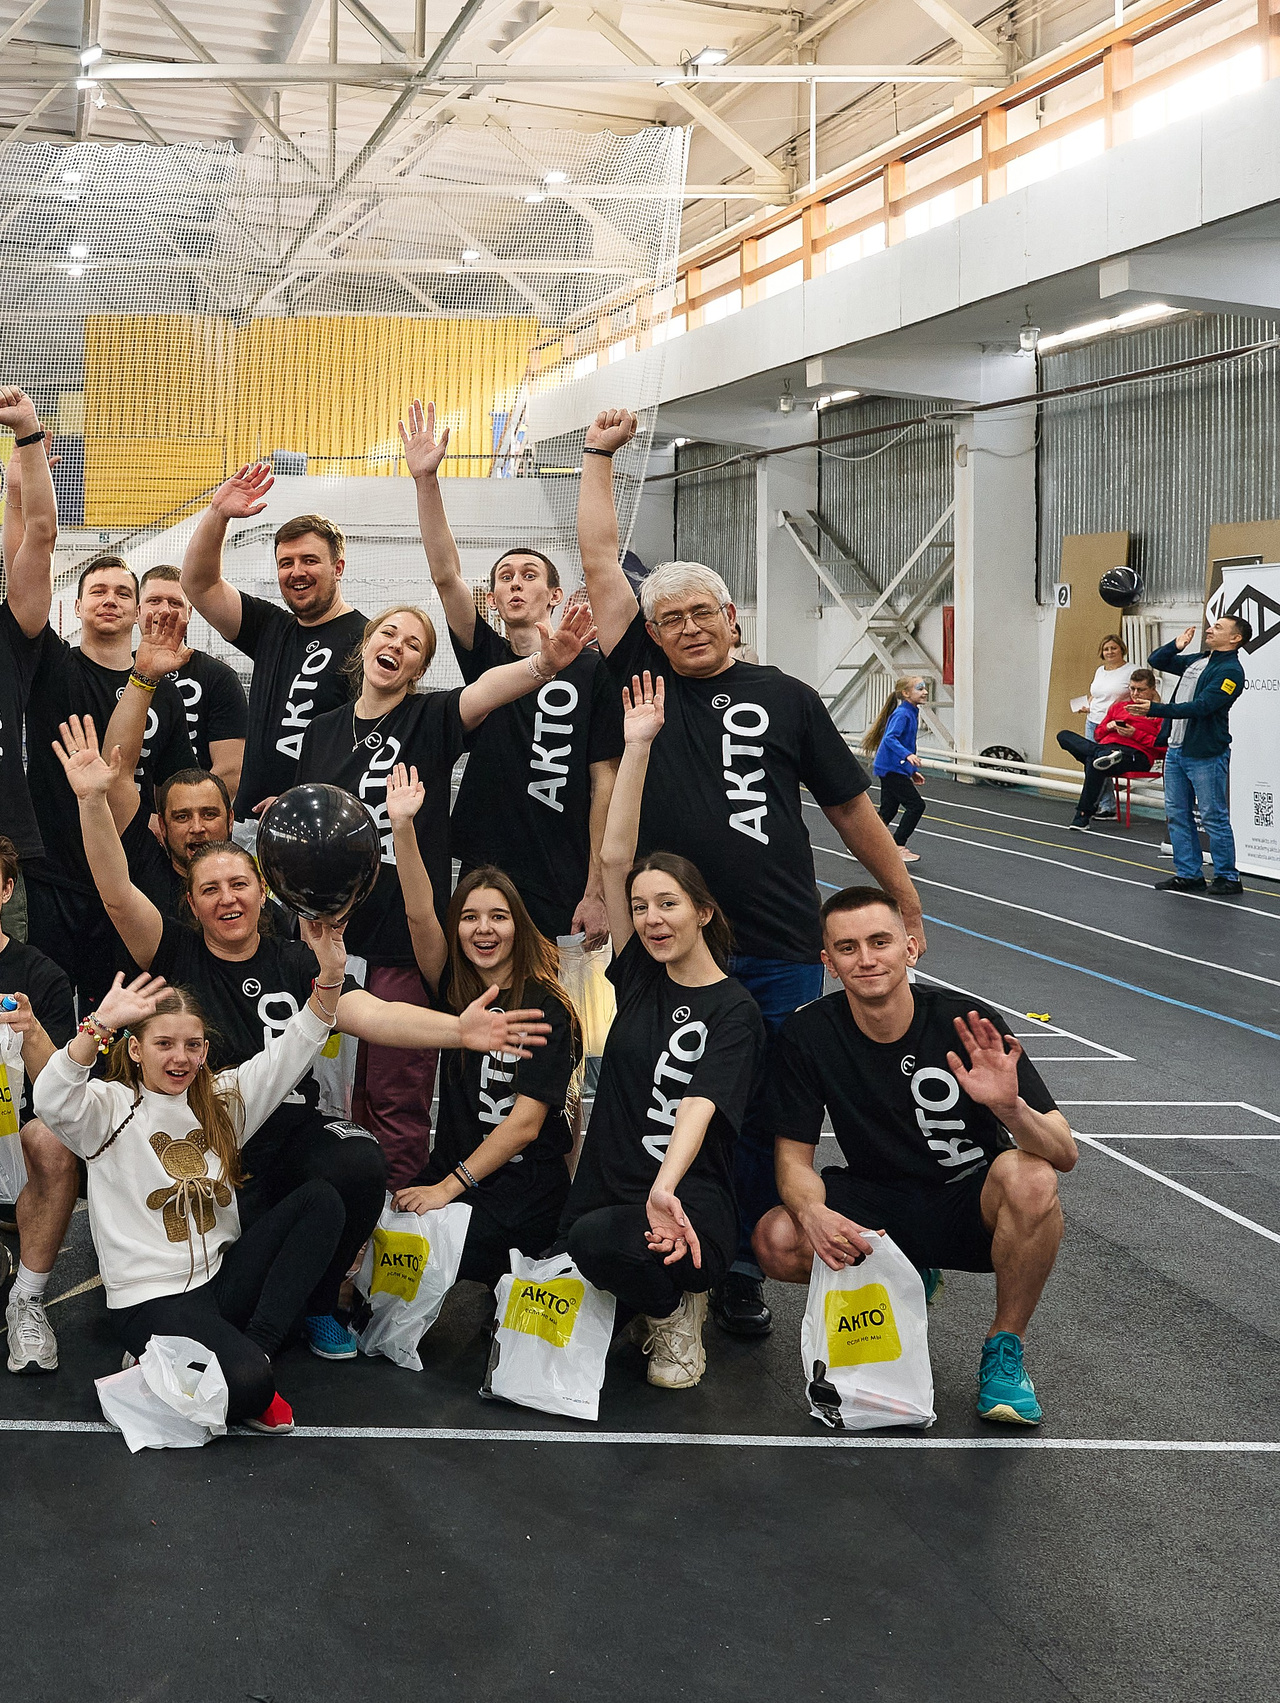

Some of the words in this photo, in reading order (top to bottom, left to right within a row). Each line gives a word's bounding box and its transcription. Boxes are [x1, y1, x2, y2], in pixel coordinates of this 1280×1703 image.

[276, 647, 333, 761] АКТО
[527, 680, 579, 812] АКТО
[722, 702, 770, 845] АКТО
[380, 1252, 419, 1272] АКТО
[521, 1285, 570, 1316] АКТО
[838, 1309, 885, 1333] АКТО
